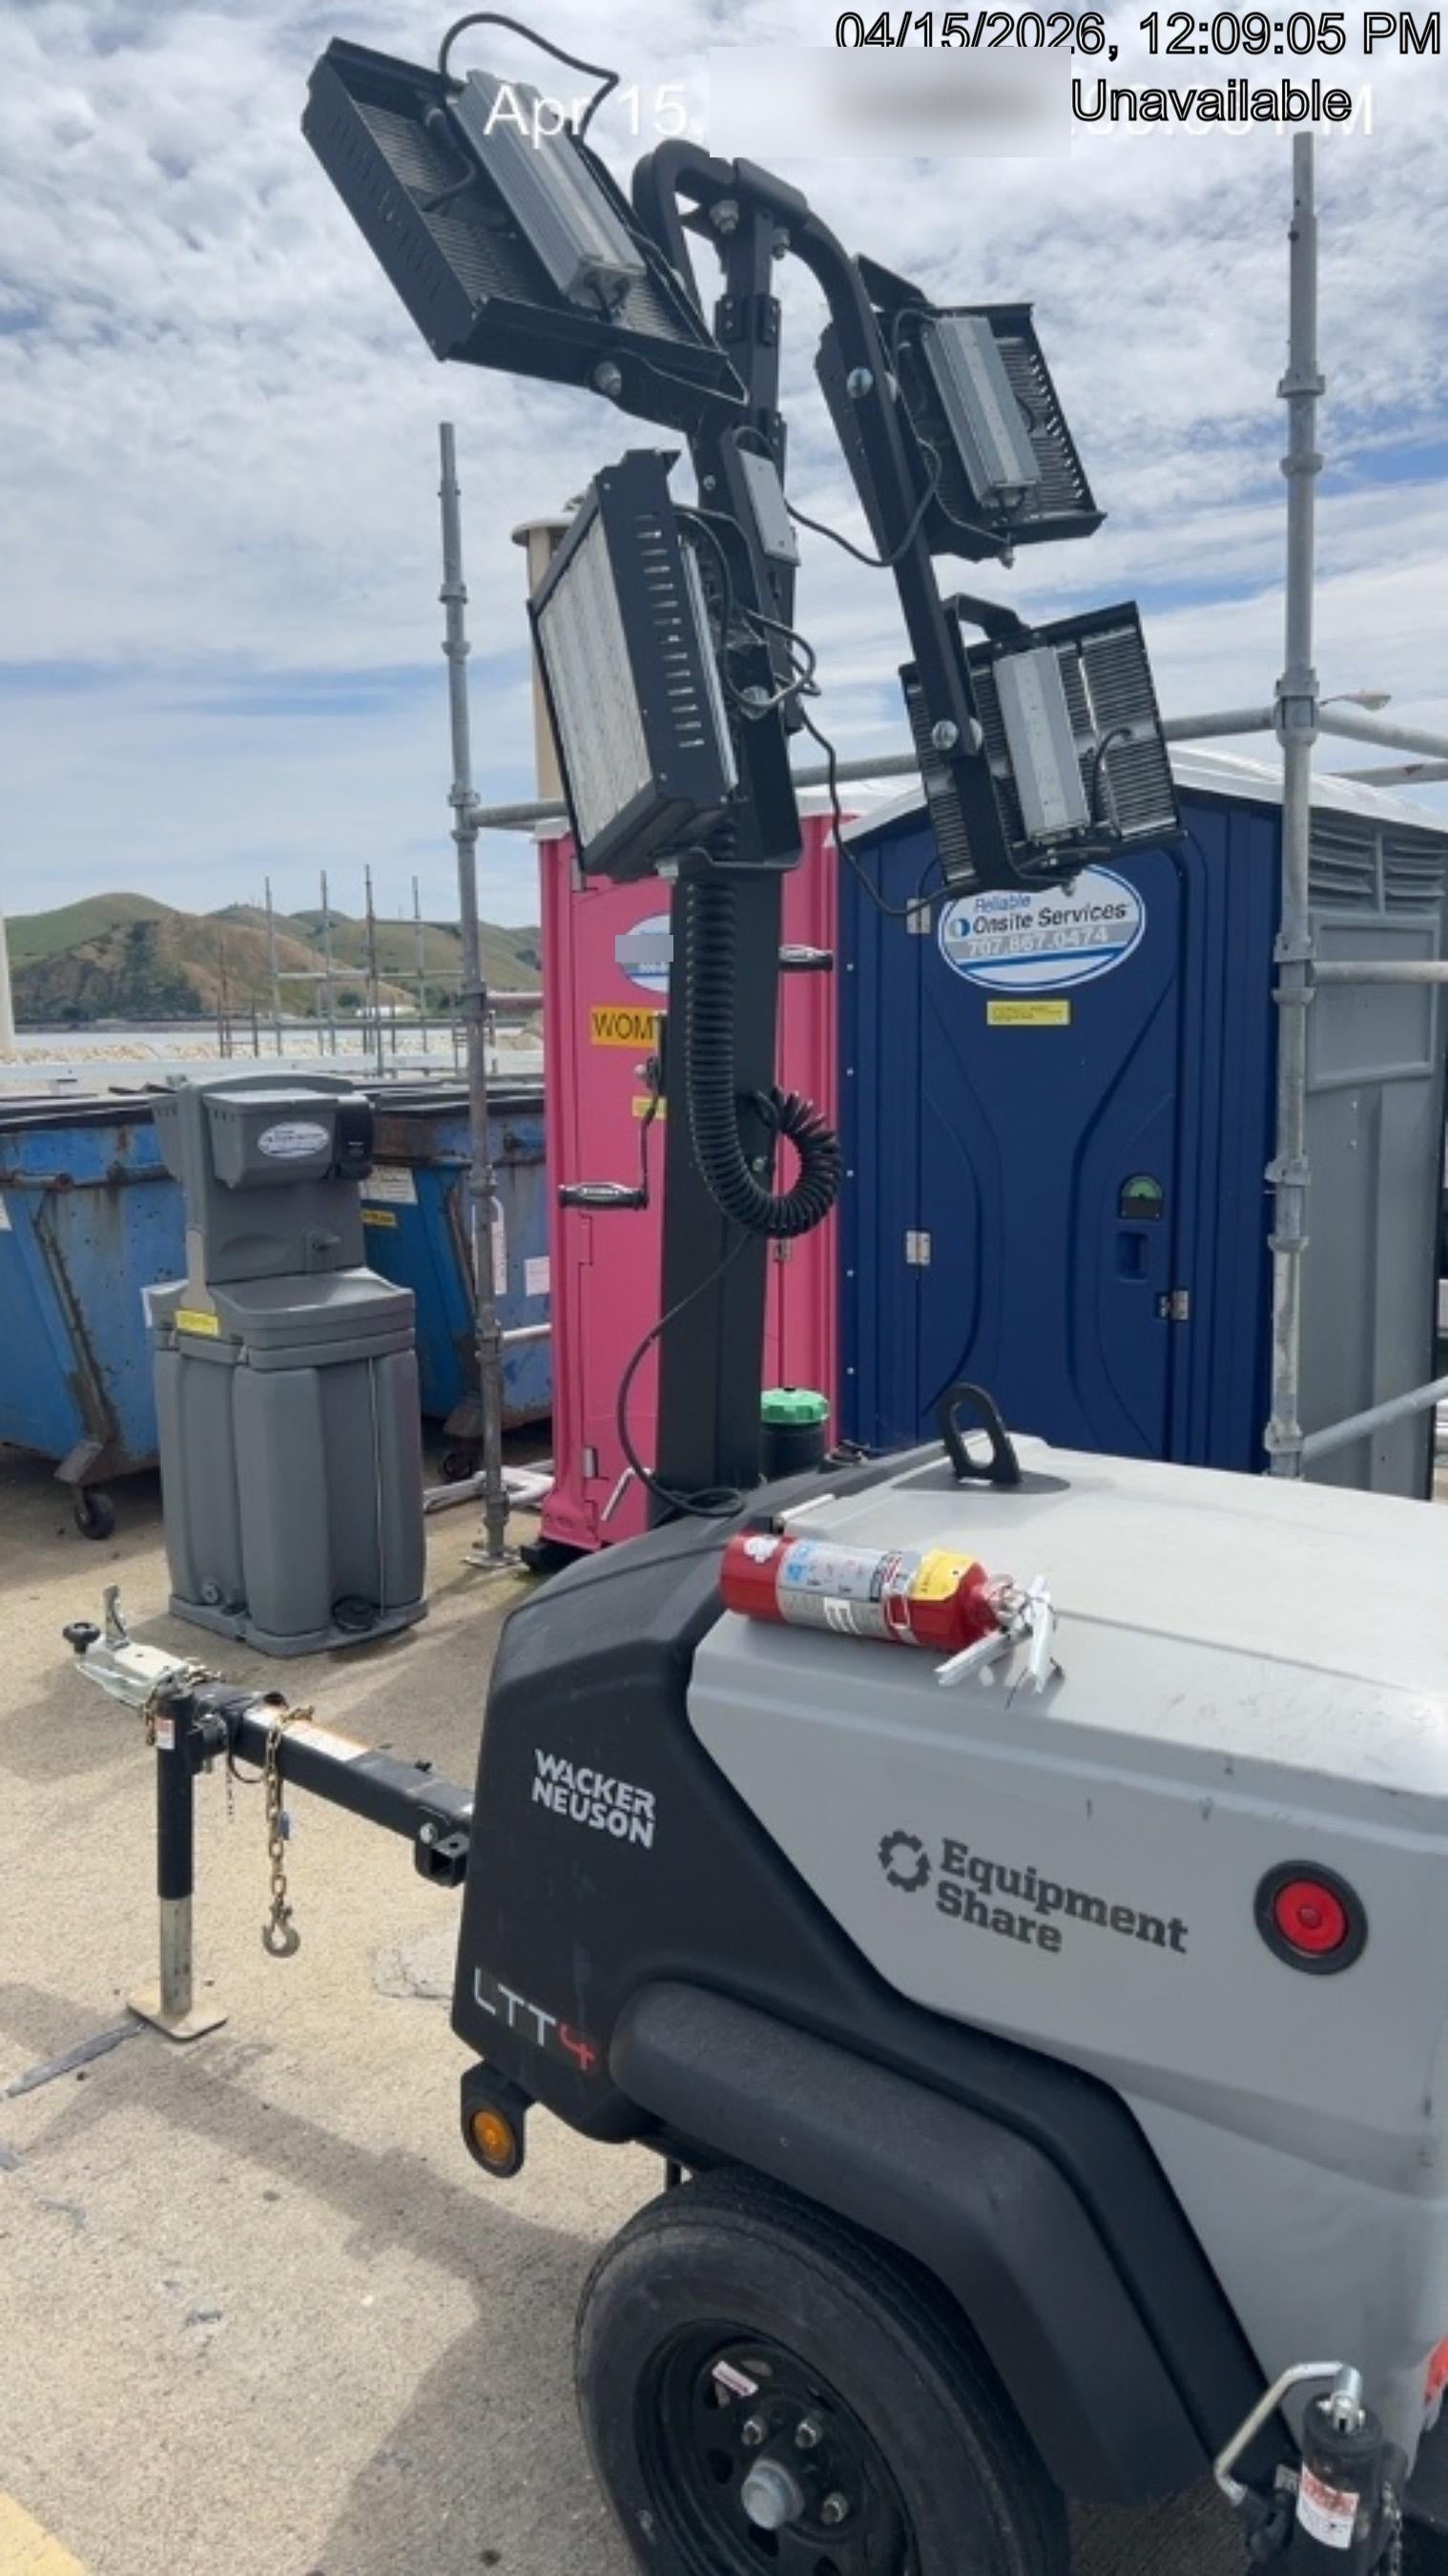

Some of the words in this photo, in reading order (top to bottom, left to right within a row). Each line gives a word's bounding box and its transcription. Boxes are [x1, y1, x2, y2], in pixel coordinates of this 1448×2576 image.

[972, 913, 1033, 935] Onsite
[1038, 904, 1127, 928] Services
[591, 1012, 655, 1041] WOM
[531, 1776, 655, 1850] NEUSON
[533, 1747, 656, 1821] WACKER
[935, 1880, 1063, 1954] Share
[940, 1837, 1189, 1955] Equipment
[473, 1966, 596, 2071] LTT4
